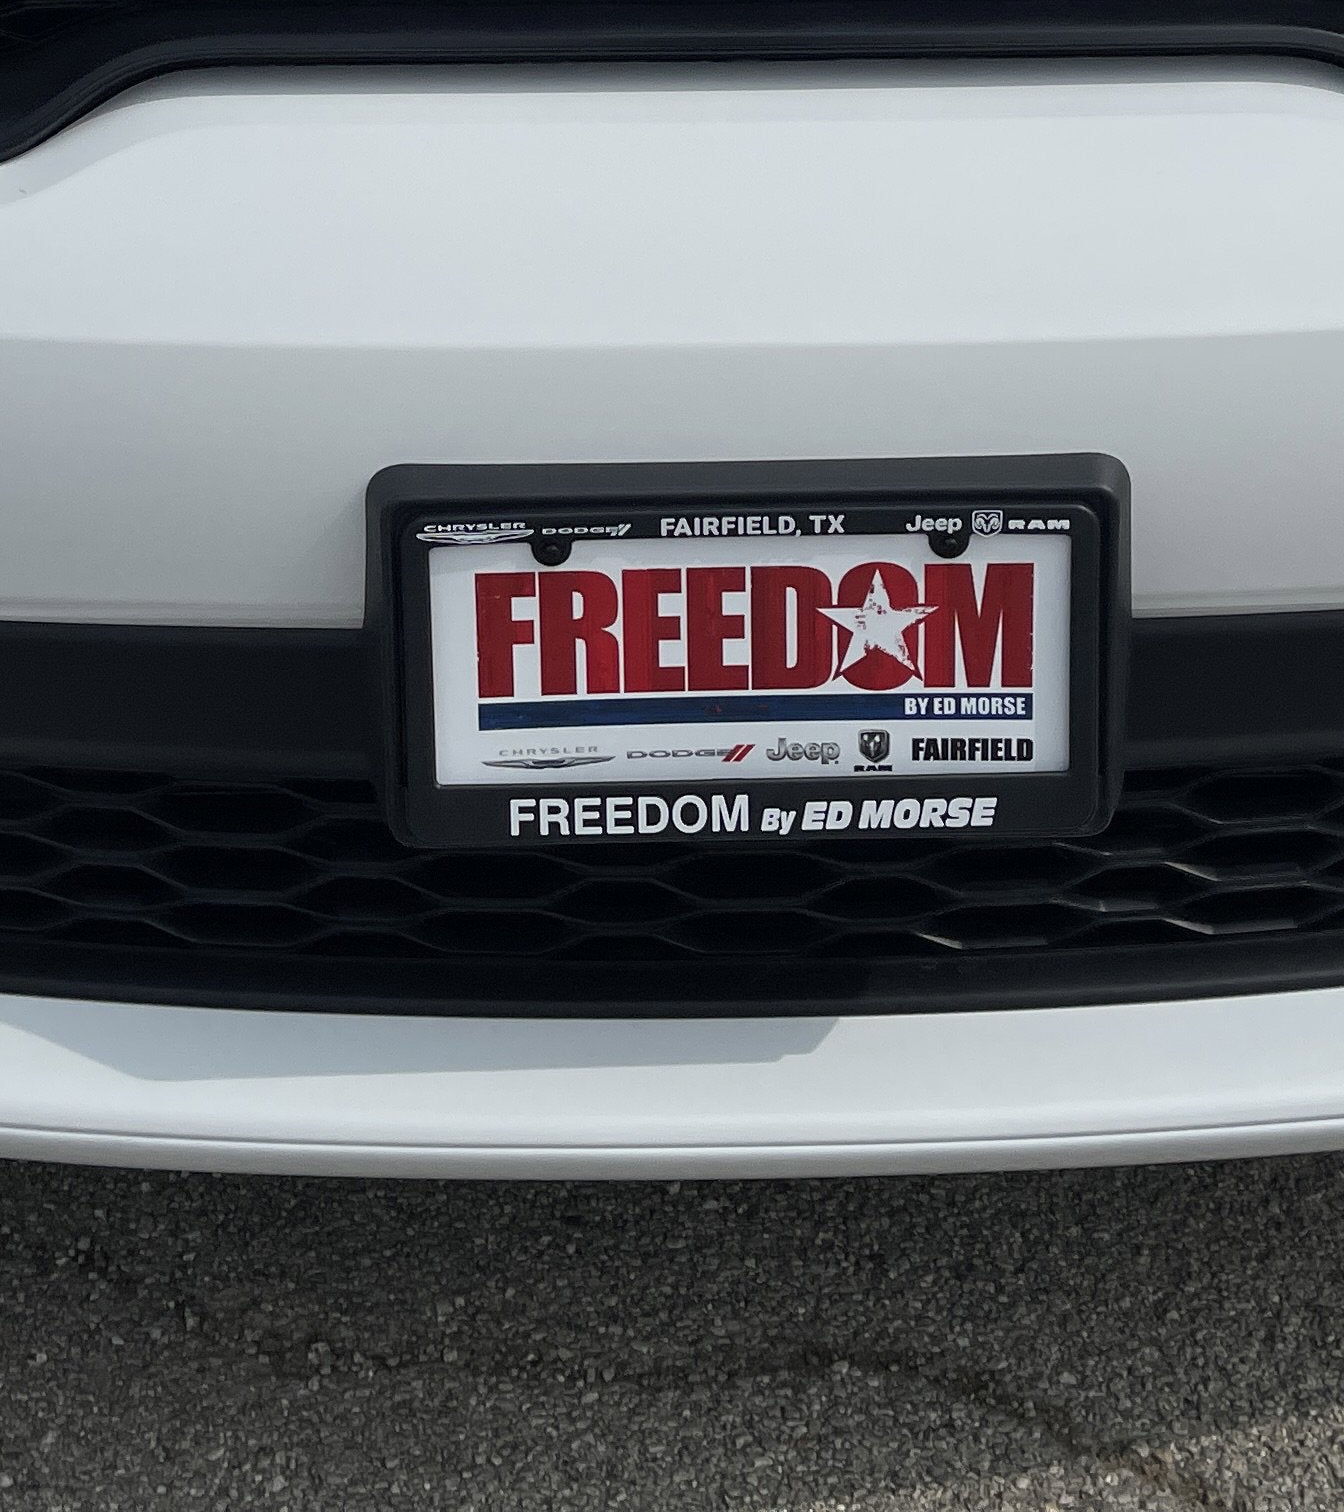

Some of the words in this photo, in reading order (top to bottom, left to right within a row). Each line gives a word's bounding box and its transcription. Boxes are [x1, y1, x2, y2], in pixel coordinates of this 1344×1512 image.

[423, 522, 526, 533] CHRYSLER
[660, 516, 802, 537] FAIRFIELD,
[809, 515, 845, 534] TX
[906, 515, 962, 534] Jeep
[1008, 519, 1070, 530] RAM
[475, 562, 1034, 697] FREEDOM
[904, 698, 928, 715] BY
[933, 697, 956, 715] ED
[960, 697, 1026, 715] MORSE
[499, 746, 598, 756] CHRYSLER
[626, 748, 735, 759] DODGE
[766, 738, 840, 764] Jeep
[911, 738, 1034, 761] FAIRFIELD
[509, 795, 749, 836] FREEDOM
[761, 808, 796, 835] By
[801, 801, 853, 830] ED
[858, 797, 997, 829] MORSE
